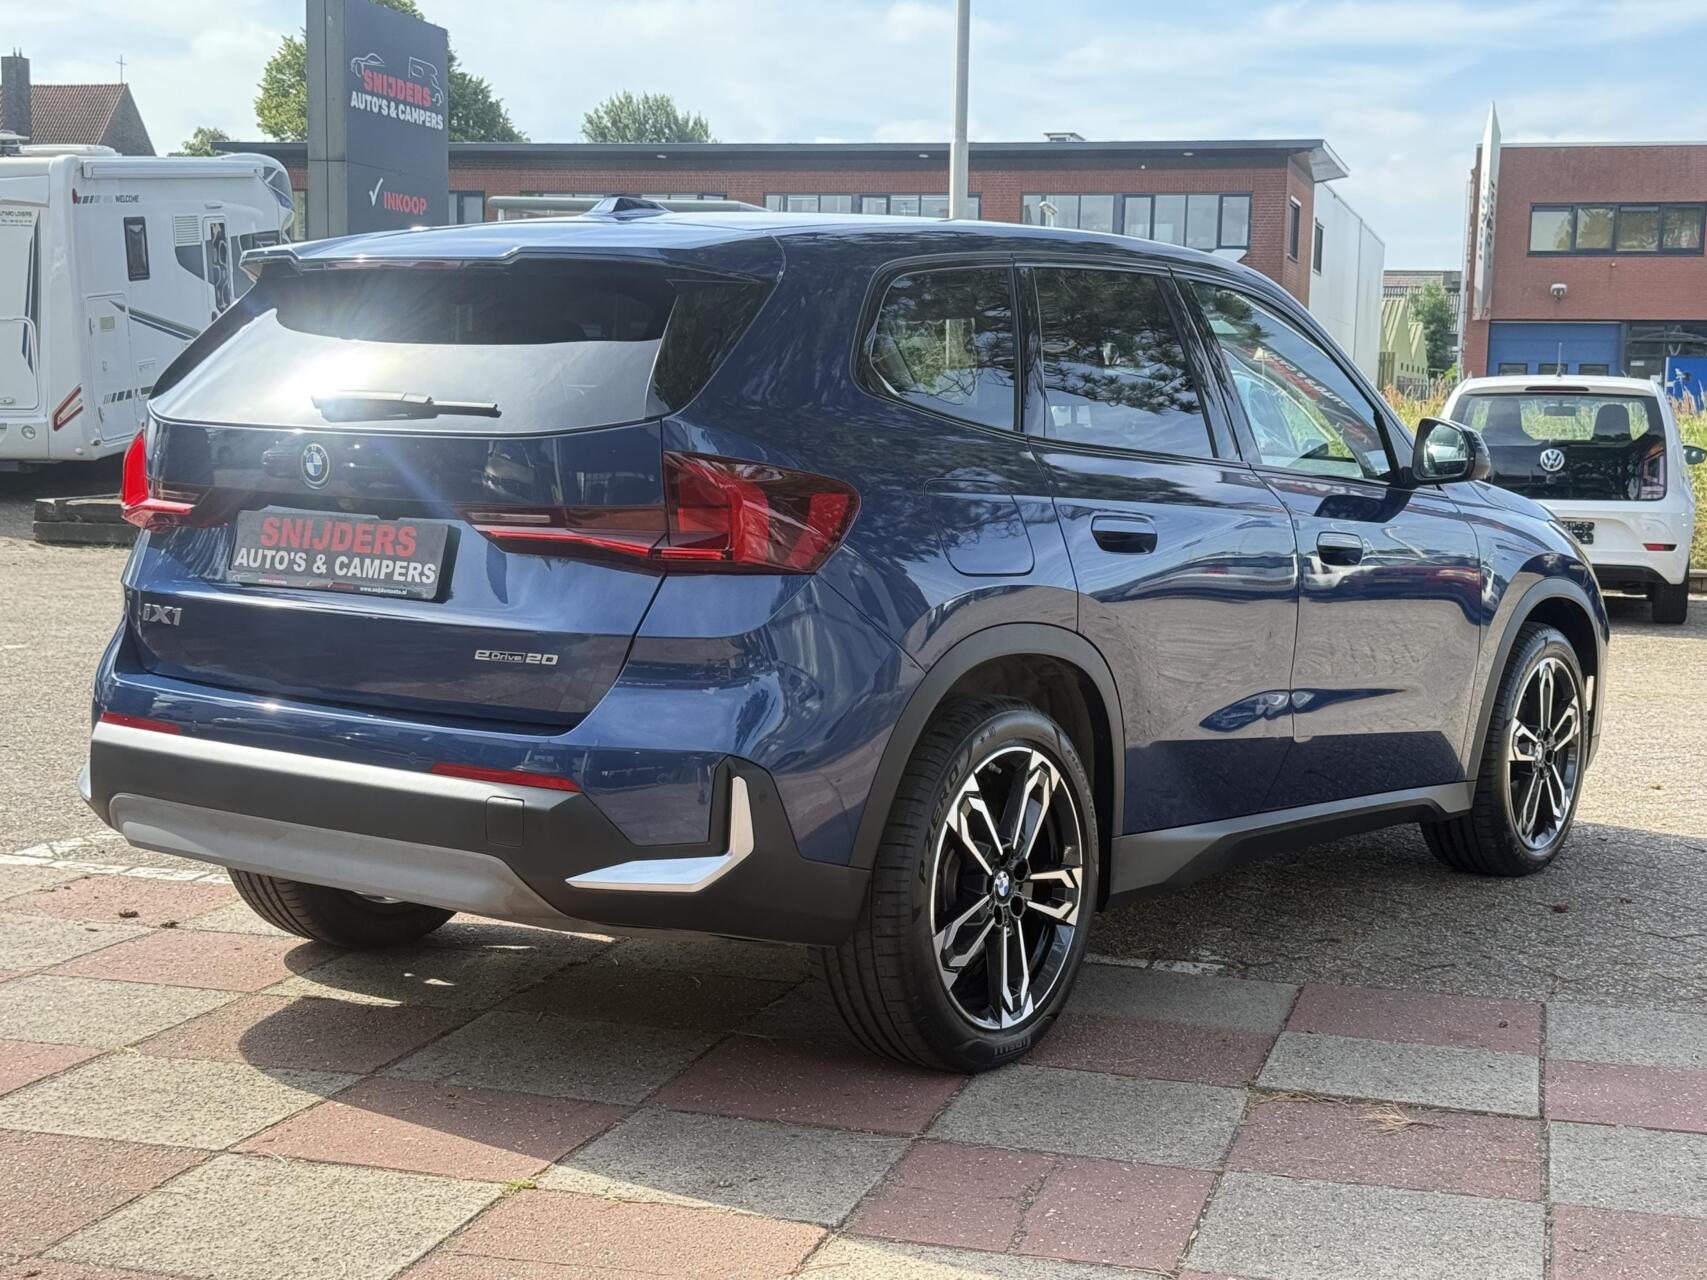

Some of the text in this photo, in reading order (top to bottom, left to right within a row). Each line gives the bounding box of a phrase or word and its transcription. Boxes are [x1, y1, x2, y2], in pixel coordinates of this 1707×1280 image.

[363, 69, 432, 106] SNIJDERS
[351, 91, 444, 130] AUTO'S & CAMPERS
[383, 191, 428, 215] INKOOP
[260, 516, 417, 557] SNIJDERS
[234, 547, 436, 584] AUTO'S & CAMPERS
[142, 603, 183, 627] iX1
